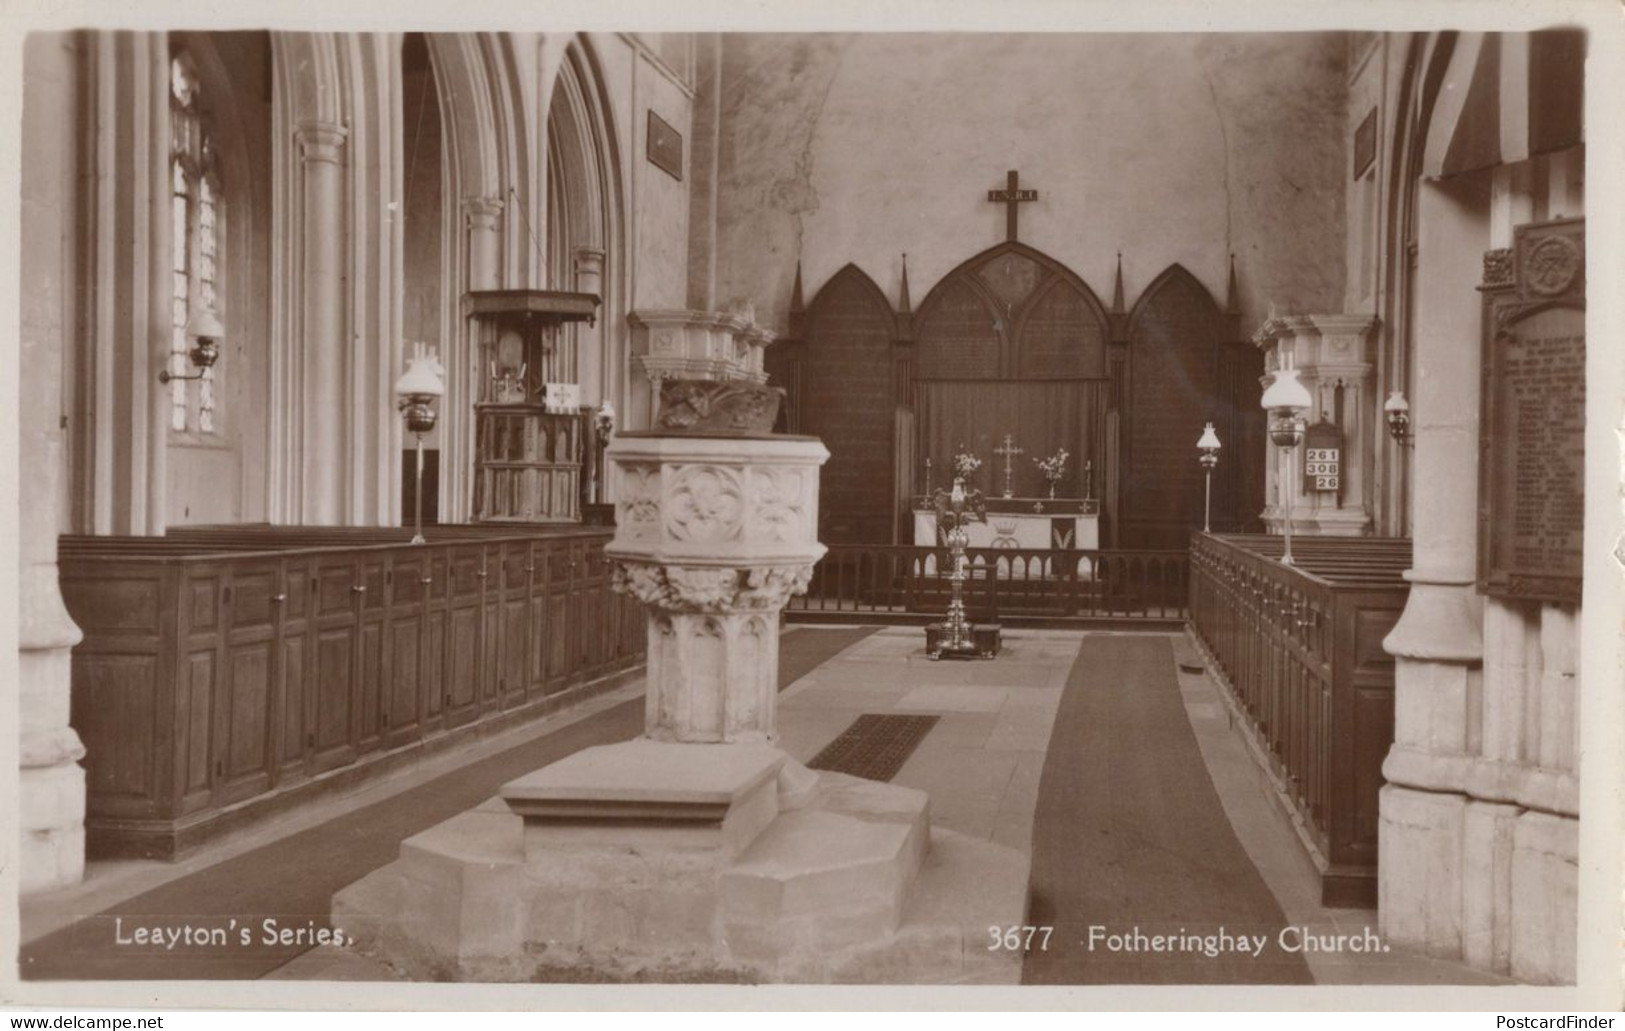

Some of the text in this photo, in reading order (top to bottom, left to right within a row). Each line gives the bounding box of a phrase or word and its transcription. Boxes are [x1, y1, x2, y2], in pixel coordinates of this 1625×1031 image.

[1308, 450, 1337, 460] 261
[1308, 464, 1337, 473] 308
[1318, 478, 1337, 487] 26
